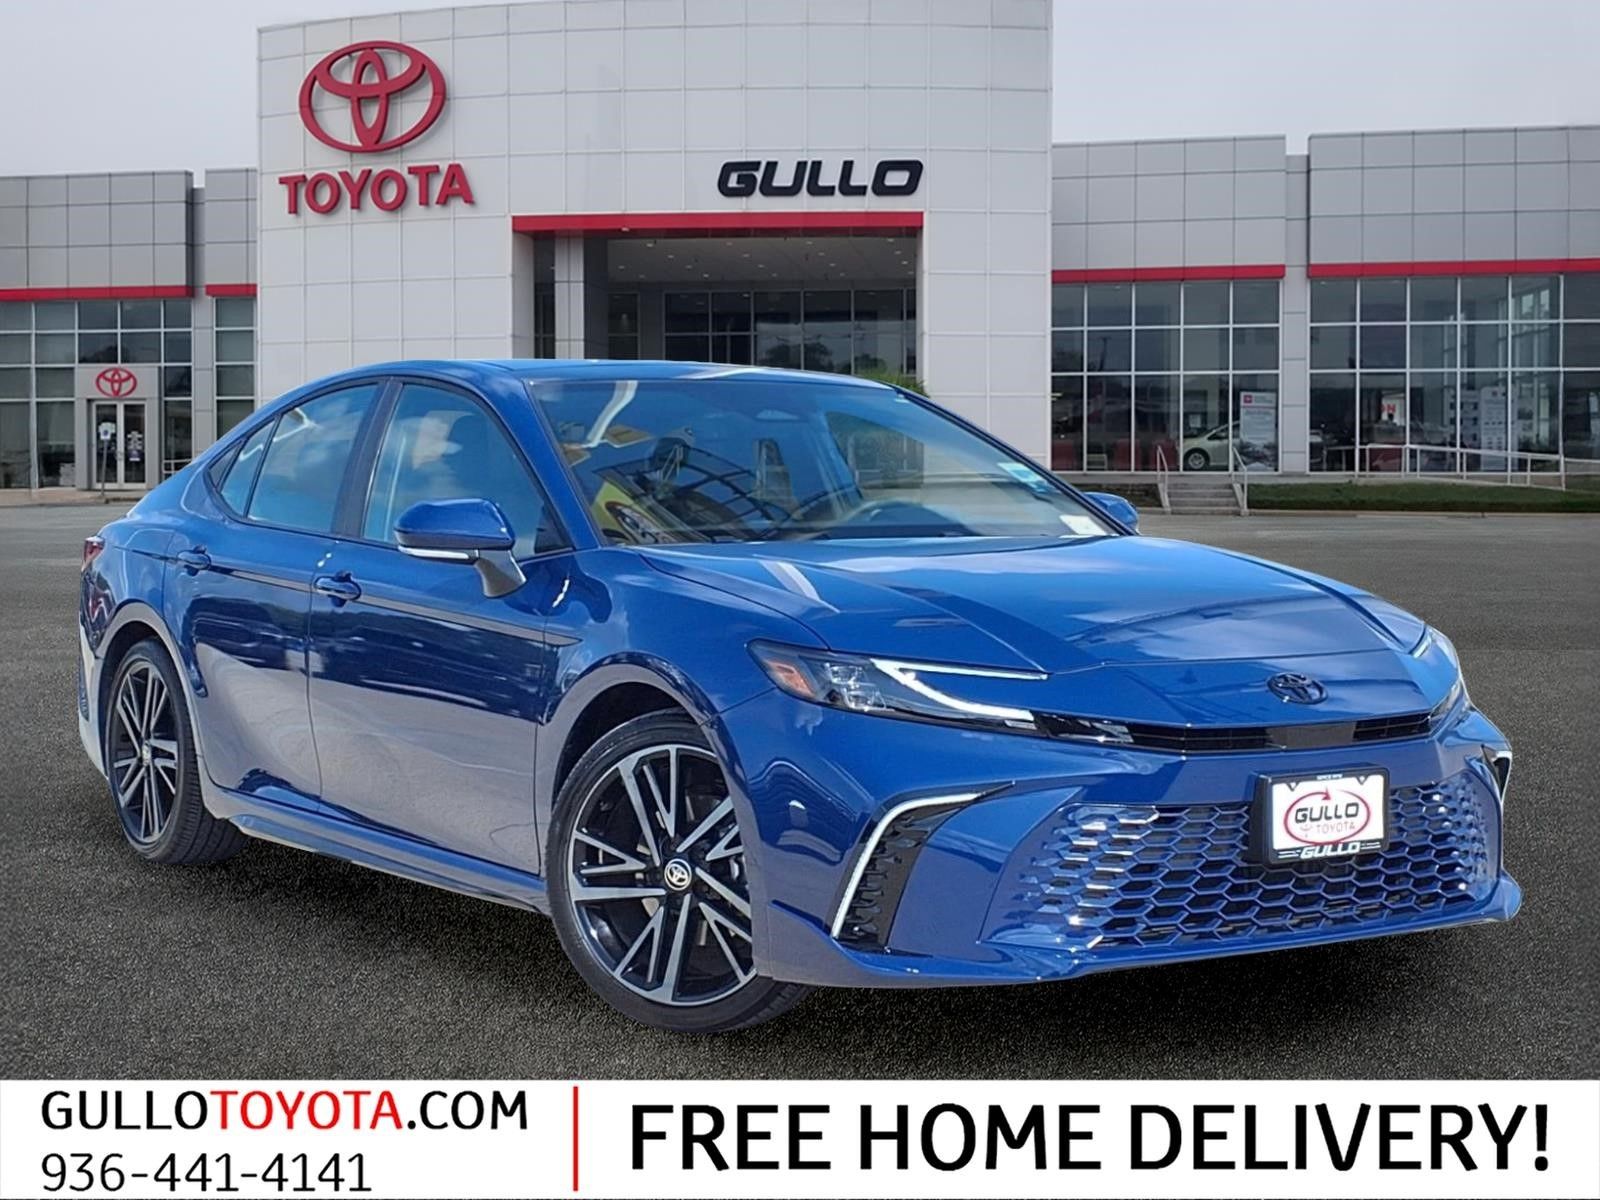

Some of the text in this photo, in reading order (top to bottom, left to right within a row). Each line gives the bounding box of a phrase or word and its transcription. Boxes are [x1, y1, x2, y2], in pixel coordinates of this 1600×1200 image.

[279, 163, 475, 214] TOYOTA
[717, 159, 924, 197] GULLO
[1295, 802, 1359, 824] GULLO
[1316, 822, 1355, 834] TOYOTA
[1300, 842, 1361, 859] GULLO
